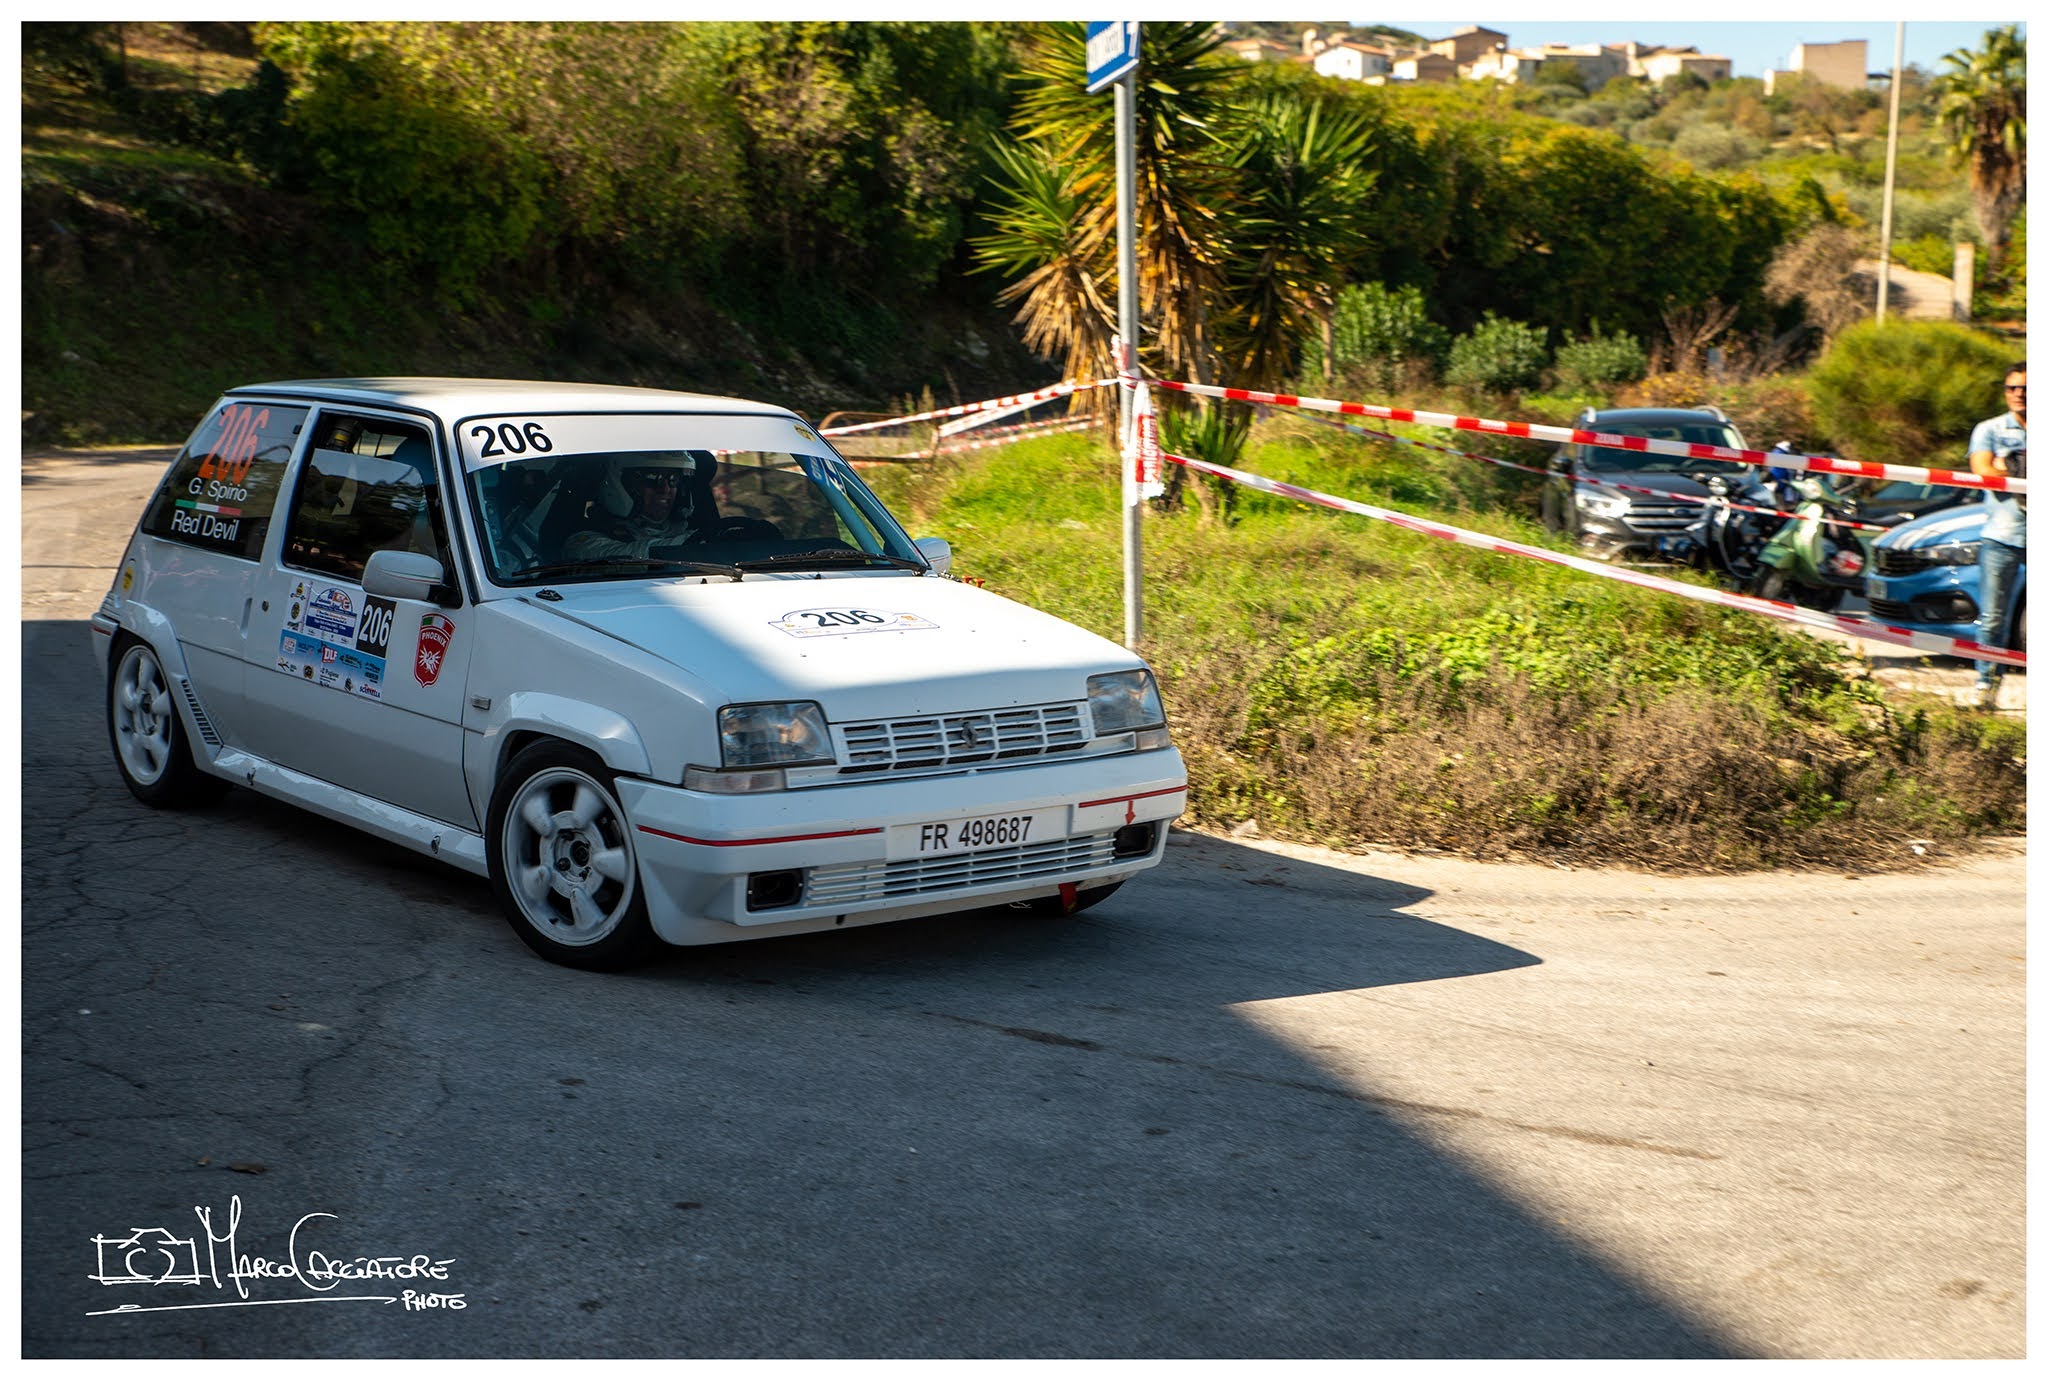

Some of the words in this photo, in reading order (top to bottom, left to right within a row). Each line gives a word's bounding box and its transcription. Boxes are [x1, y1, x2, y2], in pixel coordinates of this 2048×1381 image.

[197, 404, 270, 485] 206
[471, 421, 553, 457] 206
[188, 477, 203, 495] G.
[170, 510, 202, 535] Red
[202, 515, 240, 542] Devil
[359, 604, 392, 647] 206
[800, 609, 885, 628] 206
[421, 632, 447, 648] PHOENIX
[920, 823, 948, 851] FR
[958, 816, 1032, 846] 498687
